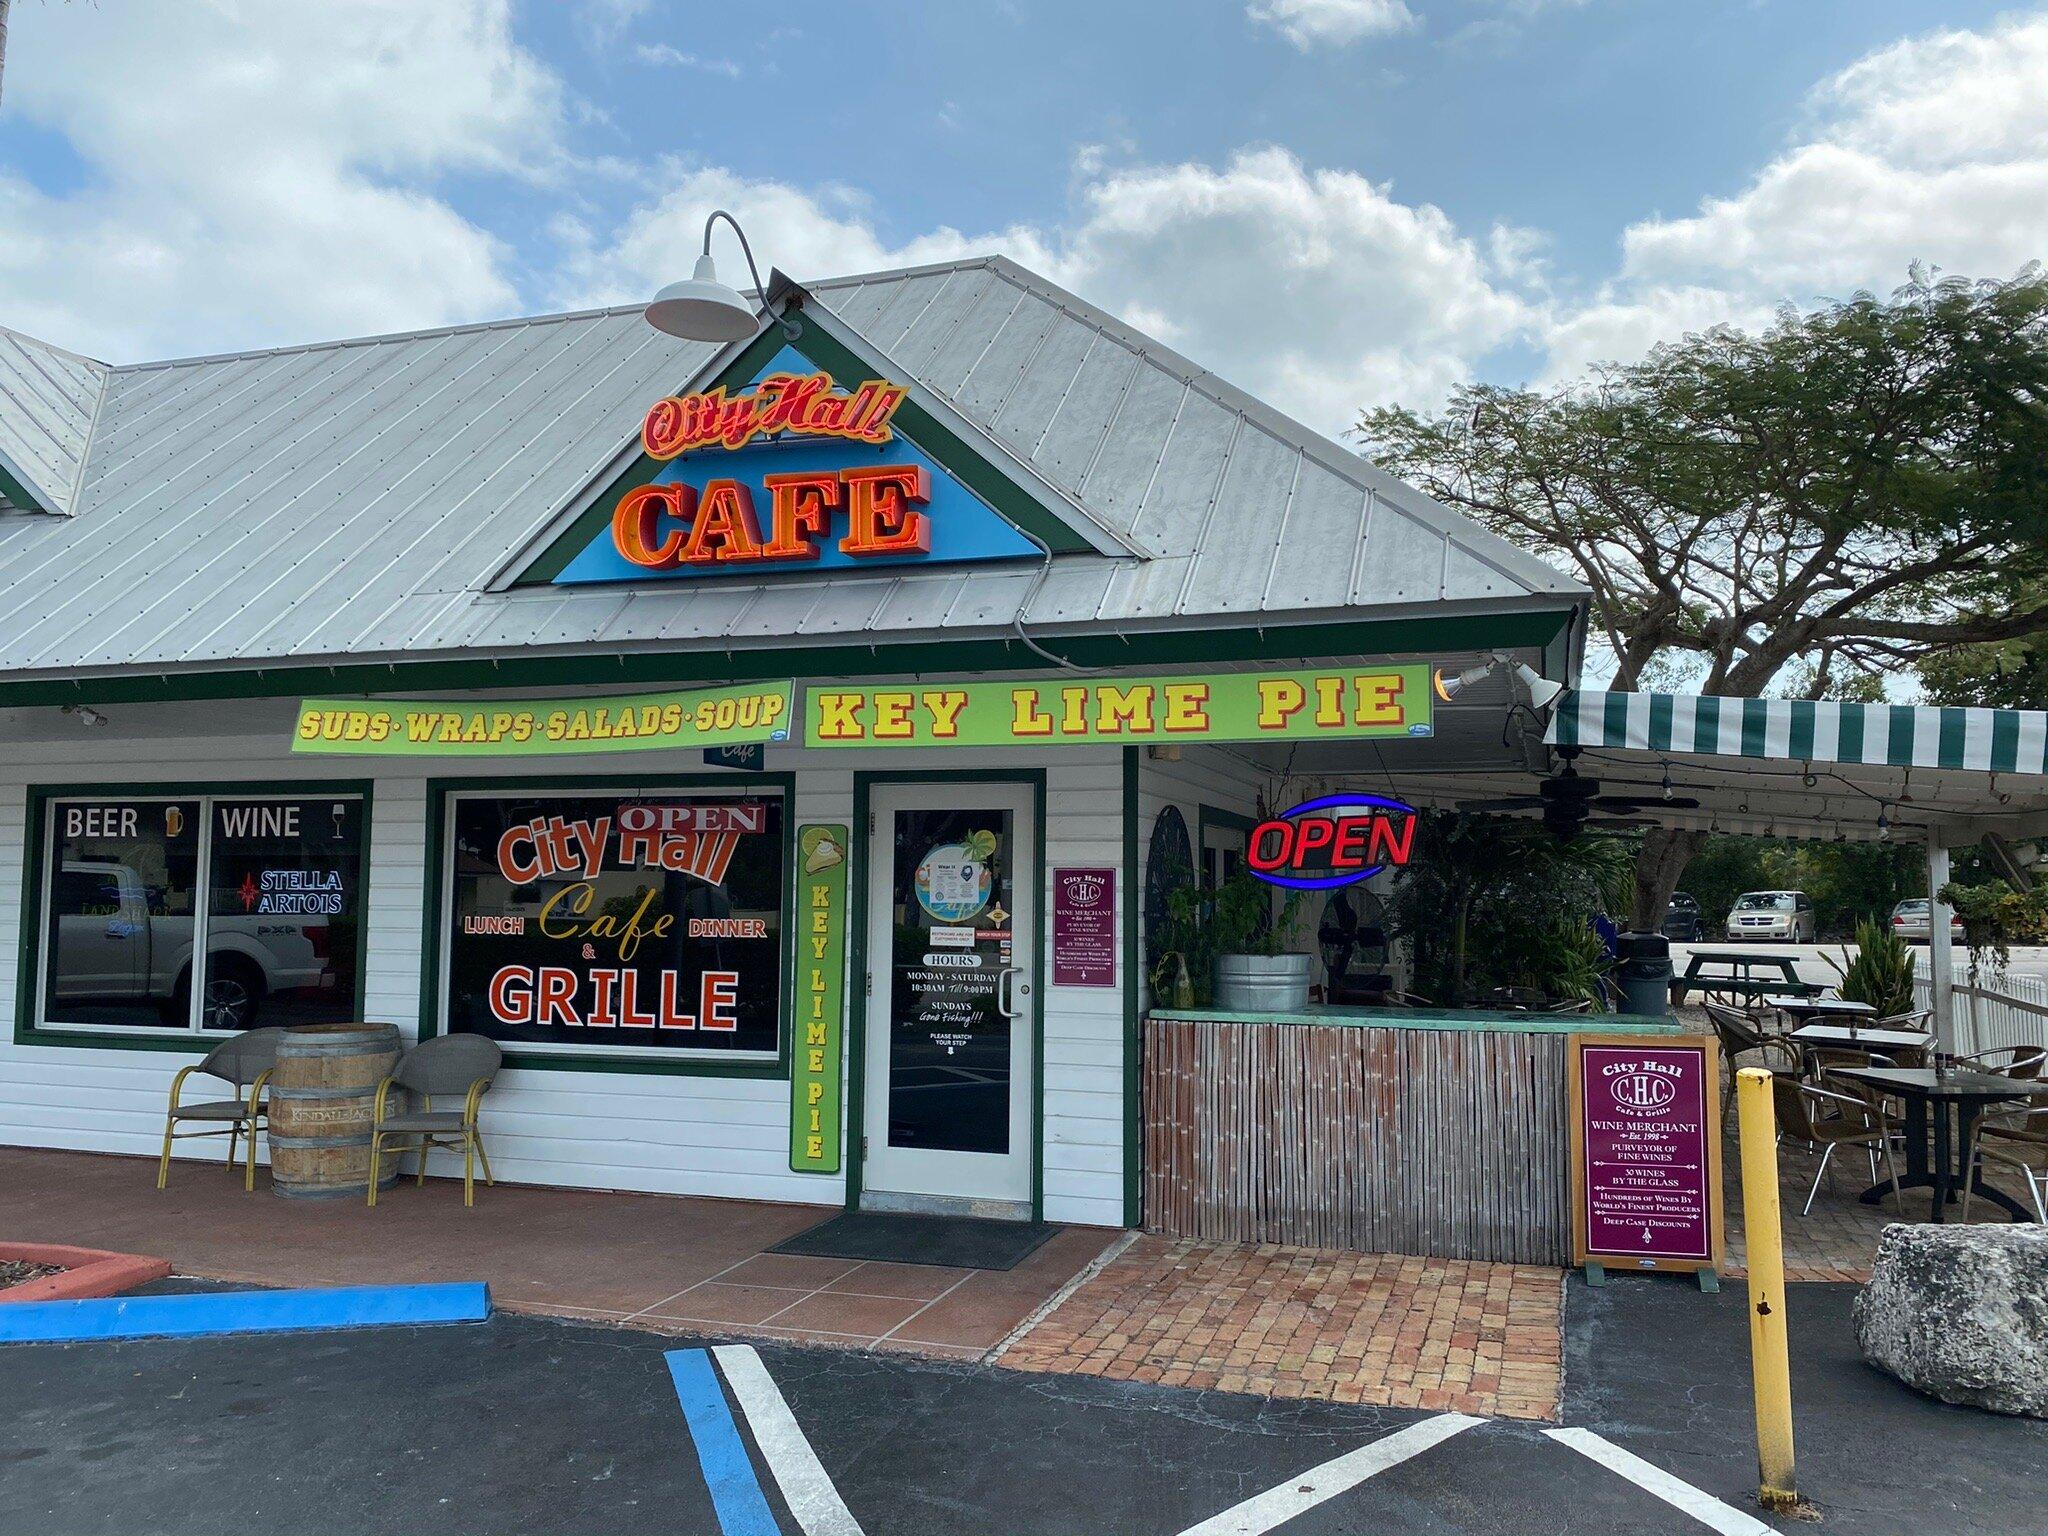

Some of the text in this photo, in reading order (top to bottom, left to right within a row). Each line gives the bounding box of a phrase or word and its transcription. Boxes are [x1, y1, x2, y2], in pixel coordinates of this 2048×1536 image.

[641, 371, 909, 460] City Hall
[612, 465, 931, 570] CAFE
[818, 674, 1404, 738] KEY LIME PIE
[299, 693, 784, 742] SUBS WRAPS SALADS SOUP
[721, 744, 755, 763] Cafe
[66, 807, 300, 837] BEER WINE
[620, 807, 761, 831] OPEN
[498, 816, 740, 887] City Hall
[1247, 815, 1416, 871] OPEN
[260, 870, 343, 890] STELLA
[1063, 875, 1105, 885] City Hall
[258, 893, 342, 914] ARTOIS
[539, 882, 674, 962] Cafe
[1074, 909, 1112, 917] MERCHANT
[464, 916, 524, 935] LUNCH
[688, 919, 768, 938] DINNER
[582, 943, 596, 959] &
[932, 955, 974, 966] HOURS
[907, 972, 945, 980] MONDAY
[952, 973, 998, 982] SATURDAY
[911, 983, 945, 992] 10:30AM
[488, 964, 739, 1032] GRILLE
[932, 1001, 972, 1011] SUNDAYS
[806, 886, 830, 1158] KEY LIME PIE
[919, 1011, 941, 1021] Gone
[1602, 1060, 1683, 1078] City Hall
[291, 1104, 395, 1121] KENDALL-JACKN
[1615, 1105, 1635, 1116] Cafe
[1645, 1107, 1671, 1117] Grille
[1591, 1120, 1698, 1133] WINE MERCHANT
[1629, 1132, 1660, 1141] Est. 1998
[1612, 1144, 1677, 1153] PURVEYOR OF
[1617, 1152, 1673, 1161] FINE WINES
[1612, 1177, 1679, 1187] BY THE GLASS
[1634, 1169, 1666, 1177] WINES
